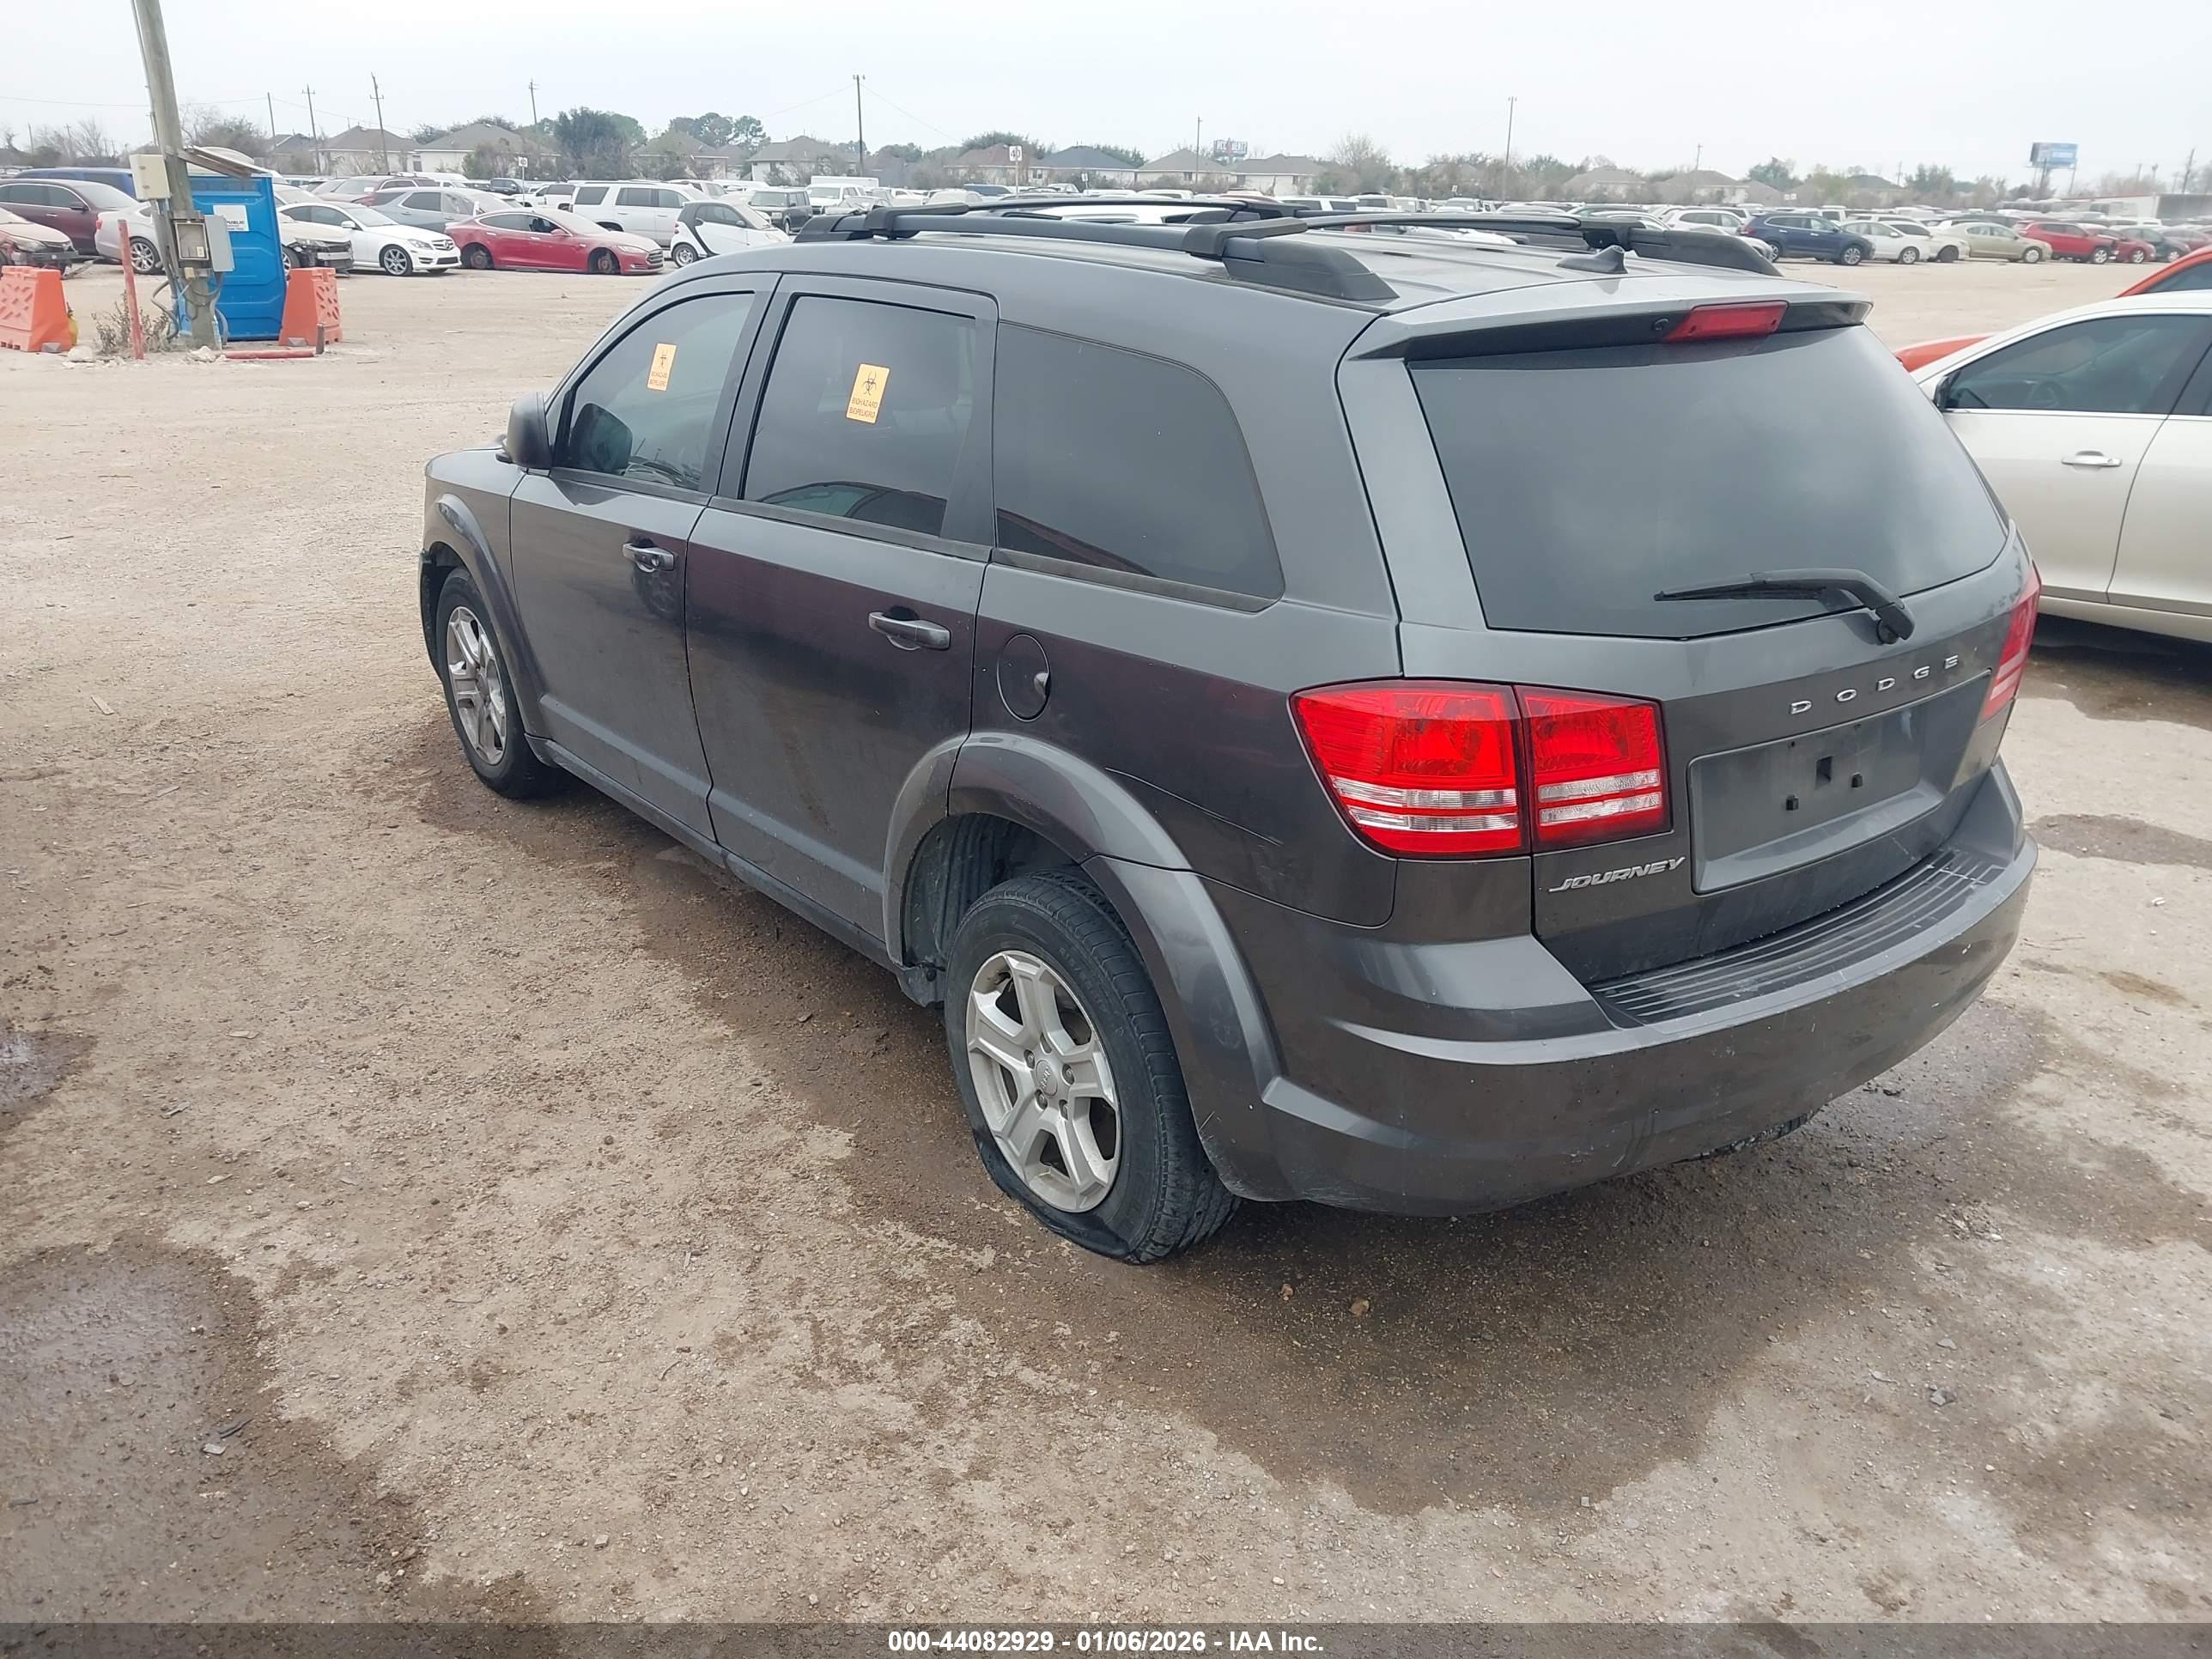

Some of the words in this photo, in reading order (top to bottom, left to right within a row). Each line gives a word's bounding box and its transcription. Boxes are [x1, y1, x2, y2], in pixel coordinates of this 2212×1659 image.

[851, 397, 878, 408] BIOHAZARD
[1790, 654, 1959, 714] DODGE
[1548, 856, 1686, 893] JOURNEY
